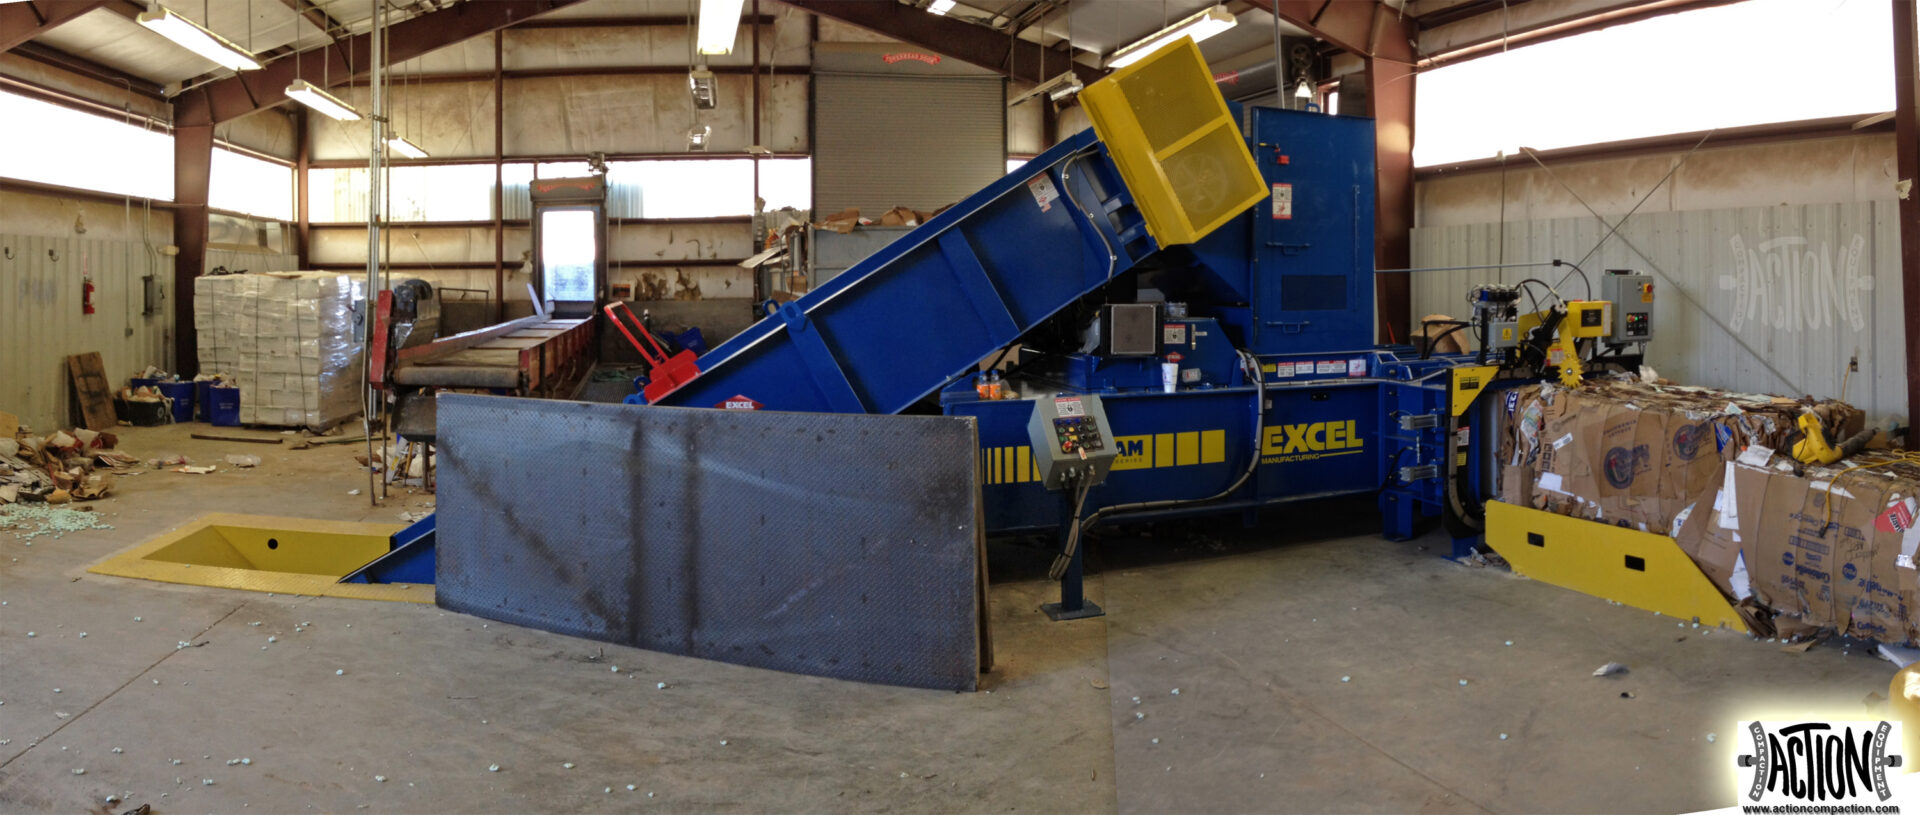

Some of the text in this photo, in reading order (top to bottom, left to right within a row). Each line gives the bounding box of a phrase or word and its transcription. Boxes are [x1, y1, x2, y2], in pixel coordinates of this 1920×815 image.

[726, 401, 755, 409] EXCEL
[1261, 419, 1364, 456] EXCEL
[1116, 439, 1143, 457] AM
[1261, 454, 1320, 465] MANUFACTURING
